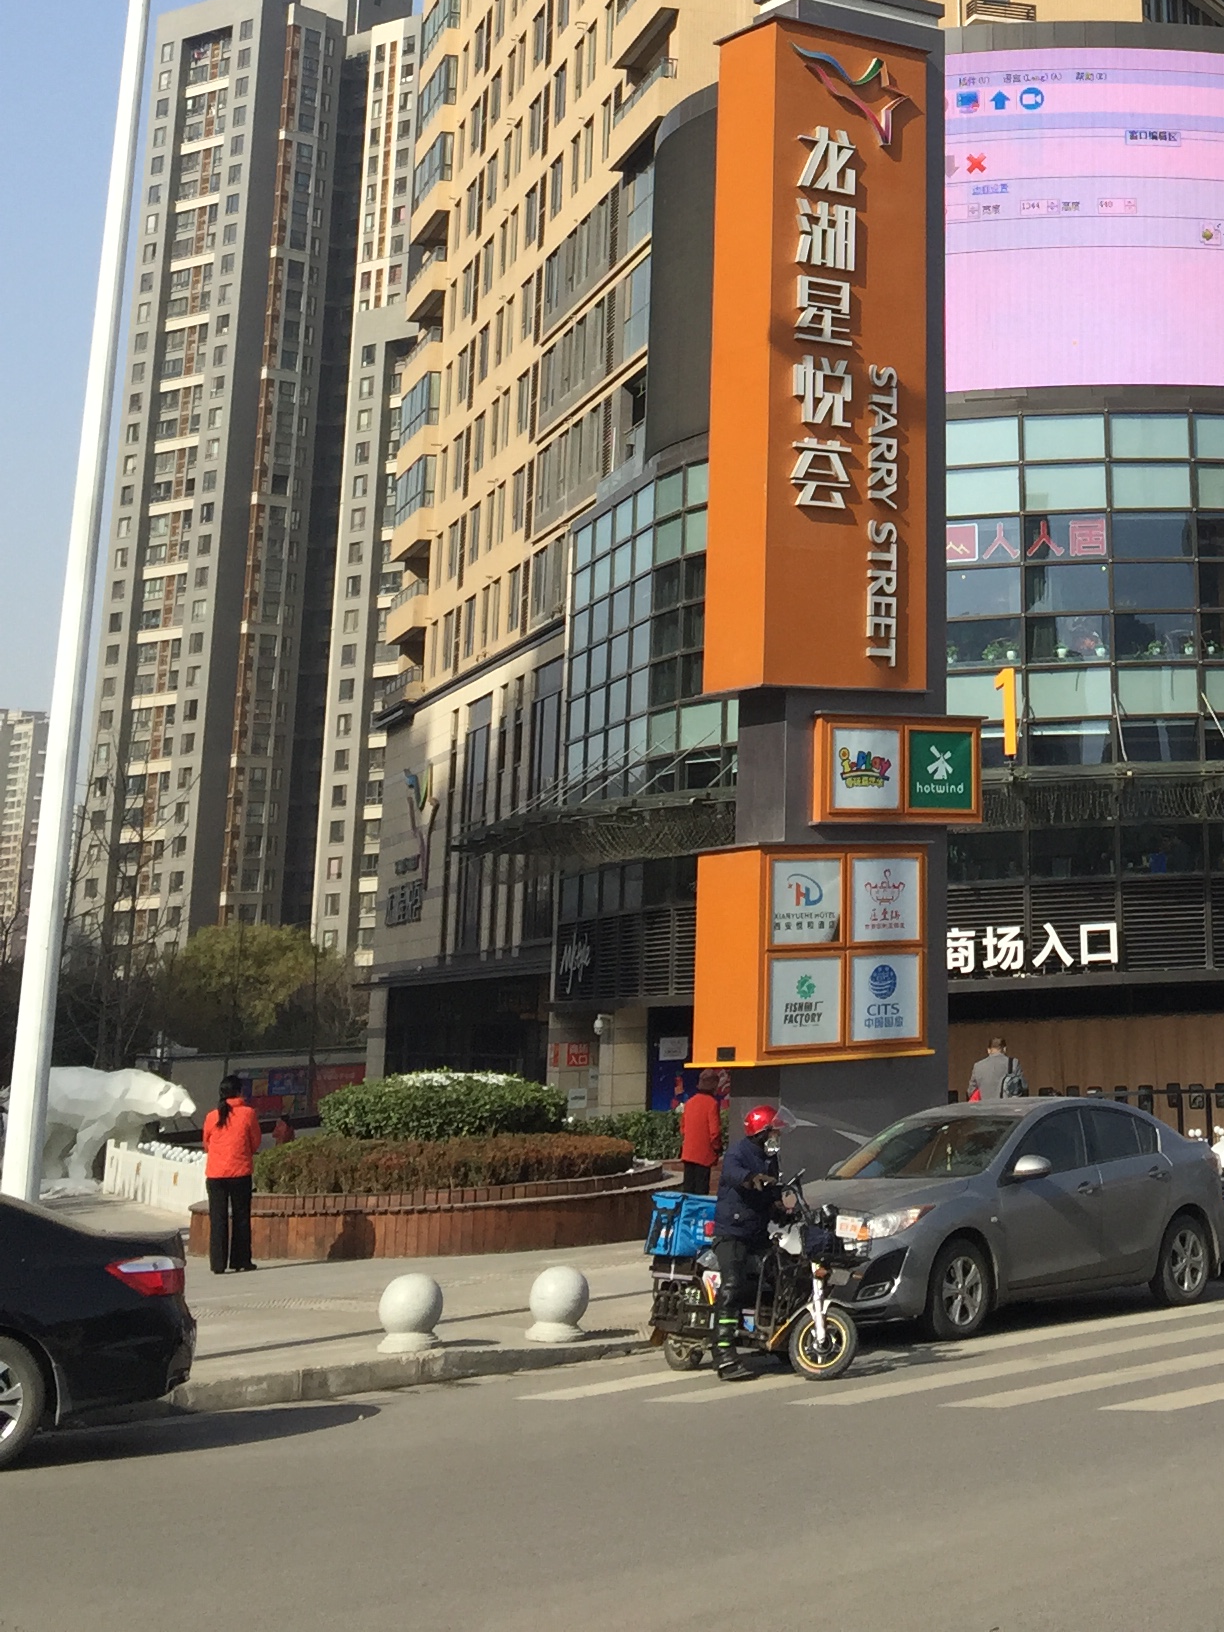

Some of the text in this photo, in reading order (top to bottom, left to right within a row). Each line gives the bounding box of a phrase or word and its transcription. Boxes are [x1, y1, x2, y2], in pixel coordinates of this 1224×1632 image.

[790, 125, 857, 511] 龙湖星悦荟
[866, 364, 898, 668] STARRY STREET
[982, 518, 1107, 561] 人人居
[916, 781, 965, 794] hotwind
[946, 921, 1119, 974] 商场入口
[784, 1002, 804, 1013] FISH
[866, 1002, 900, 1017] CITS
[783, 1012, 823, 1028] FACTORY
[569, 1055, 588, 1065] 入口
